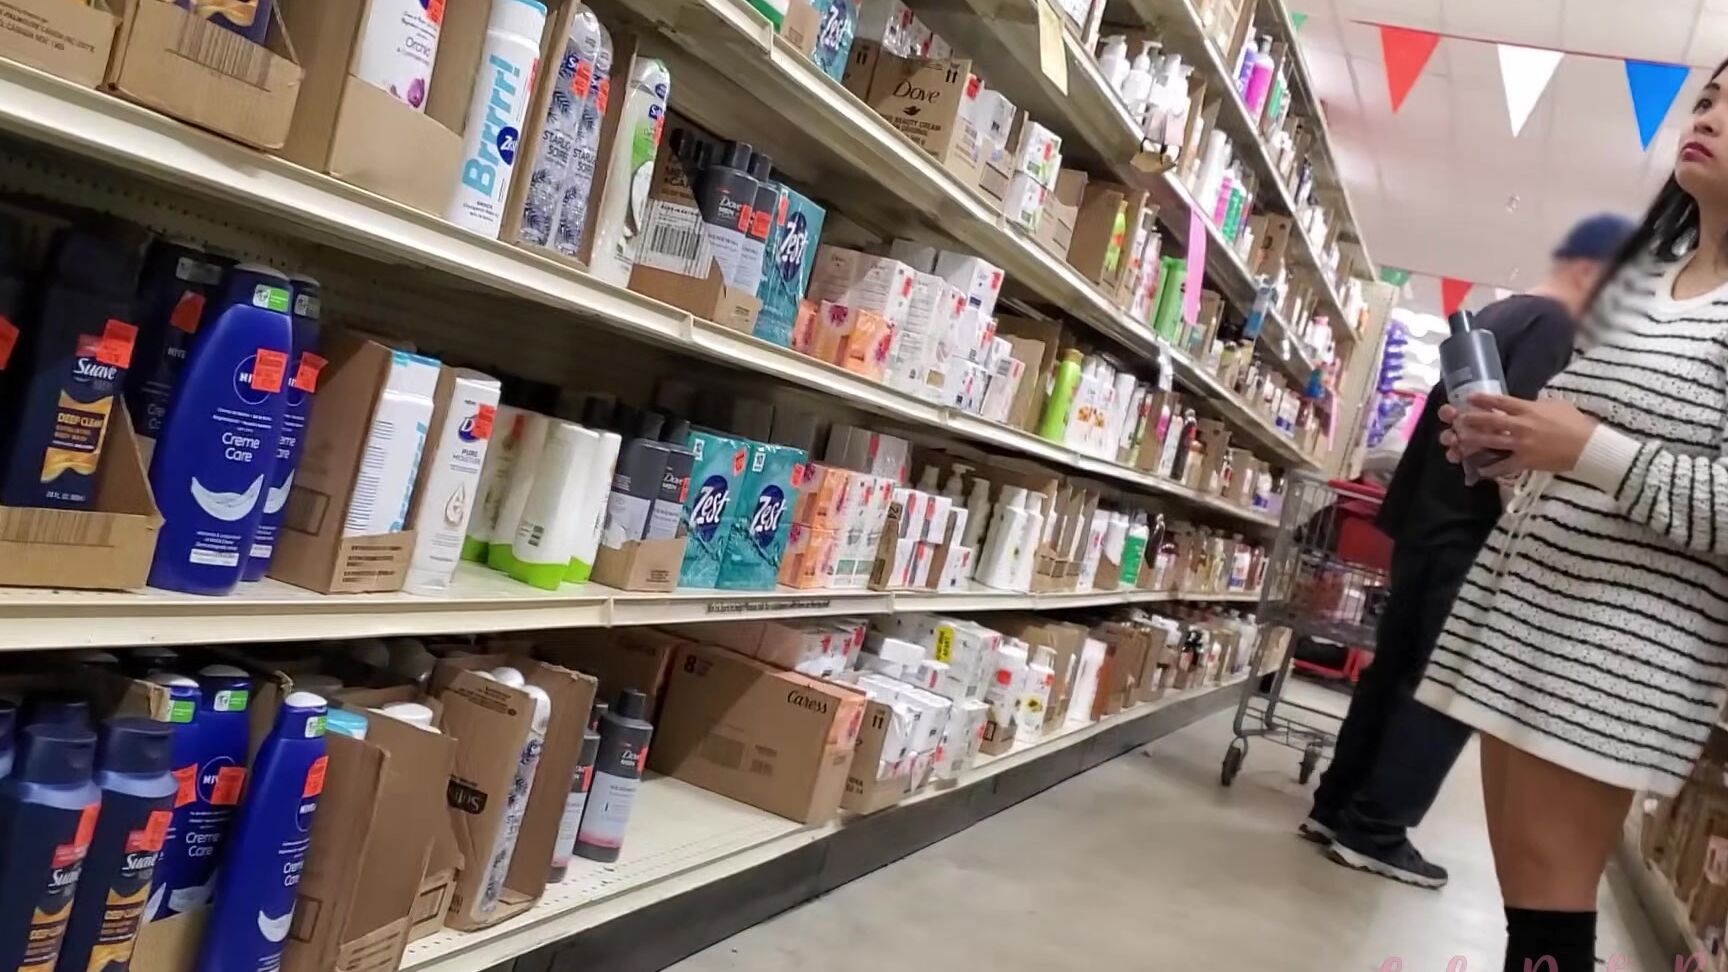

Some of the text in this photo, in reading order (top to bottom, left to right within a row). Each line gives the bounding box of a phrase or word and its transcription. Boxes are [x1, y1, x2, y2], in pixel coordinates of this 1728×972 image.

[892, 79, 940, 104] Dove
[779, 221, 809, 265] Zest
[73, 357, 117, 380] Suave
[222, 432, 261, 449] Creme
[225, 447, 253, 462] Care
[690, 486, 730, 528] Zest
[750, 496, 787, 534] Zest
[684, 655, 697, 673] 8
[787, 689, 827, 714] Caress
